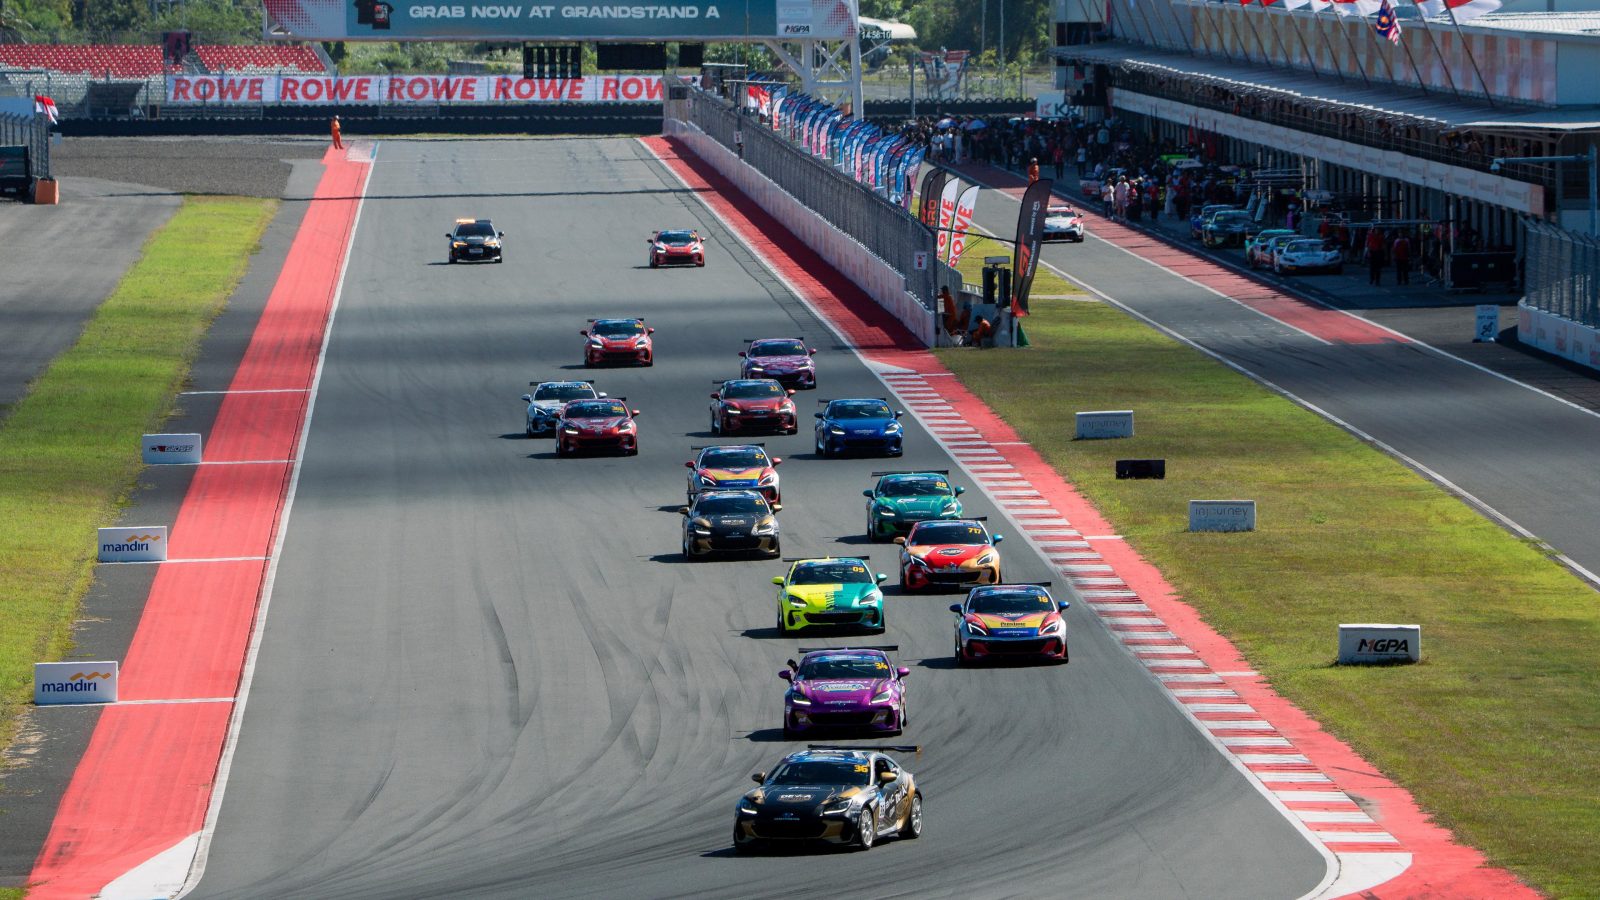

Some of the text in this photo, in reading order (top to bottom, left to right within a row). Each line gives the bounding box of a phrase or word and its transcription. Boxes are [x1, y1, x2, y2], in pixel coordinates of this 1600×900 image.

[409, 5, 720, 18] GRAB NOW AT GRANDSTAND A
[173, 78, 264, 100] ROWE
[281, 78, 371, 100] ROWE
[387, 78, 477, 100] ROWE
[494, 78, 585, 100] ROWE
[602, 78, 664, 100] ROW
[103, 541, 149, 552] mandiri
[875, 662, 888, 670] 34
[42, 680, 97, 693] mandiri
[854, 764, 868, 773] 36
